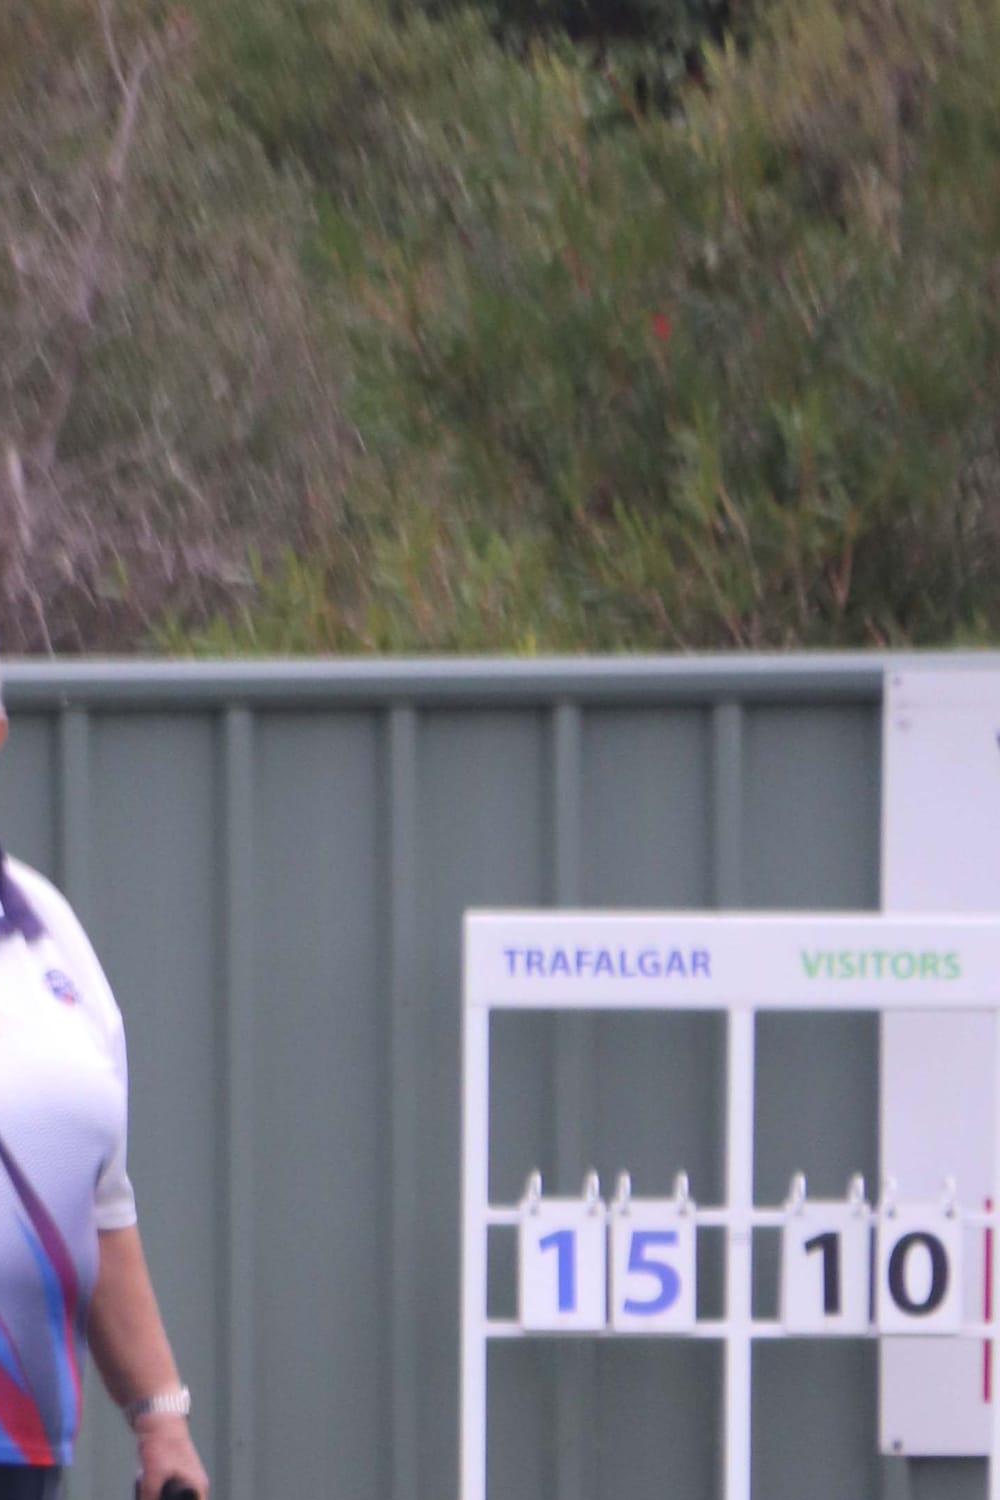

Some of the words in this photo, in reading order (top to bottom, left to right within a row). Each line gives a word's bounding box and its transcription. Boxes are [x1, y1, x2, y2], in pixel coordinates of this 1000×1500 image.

[503, 949, 710, 978] TRAFALGAR
[801, 951, 962, 980] VISITORS
[538, 1230, 682, 1316] 15
[805, 1231, 950, 1317] 10
